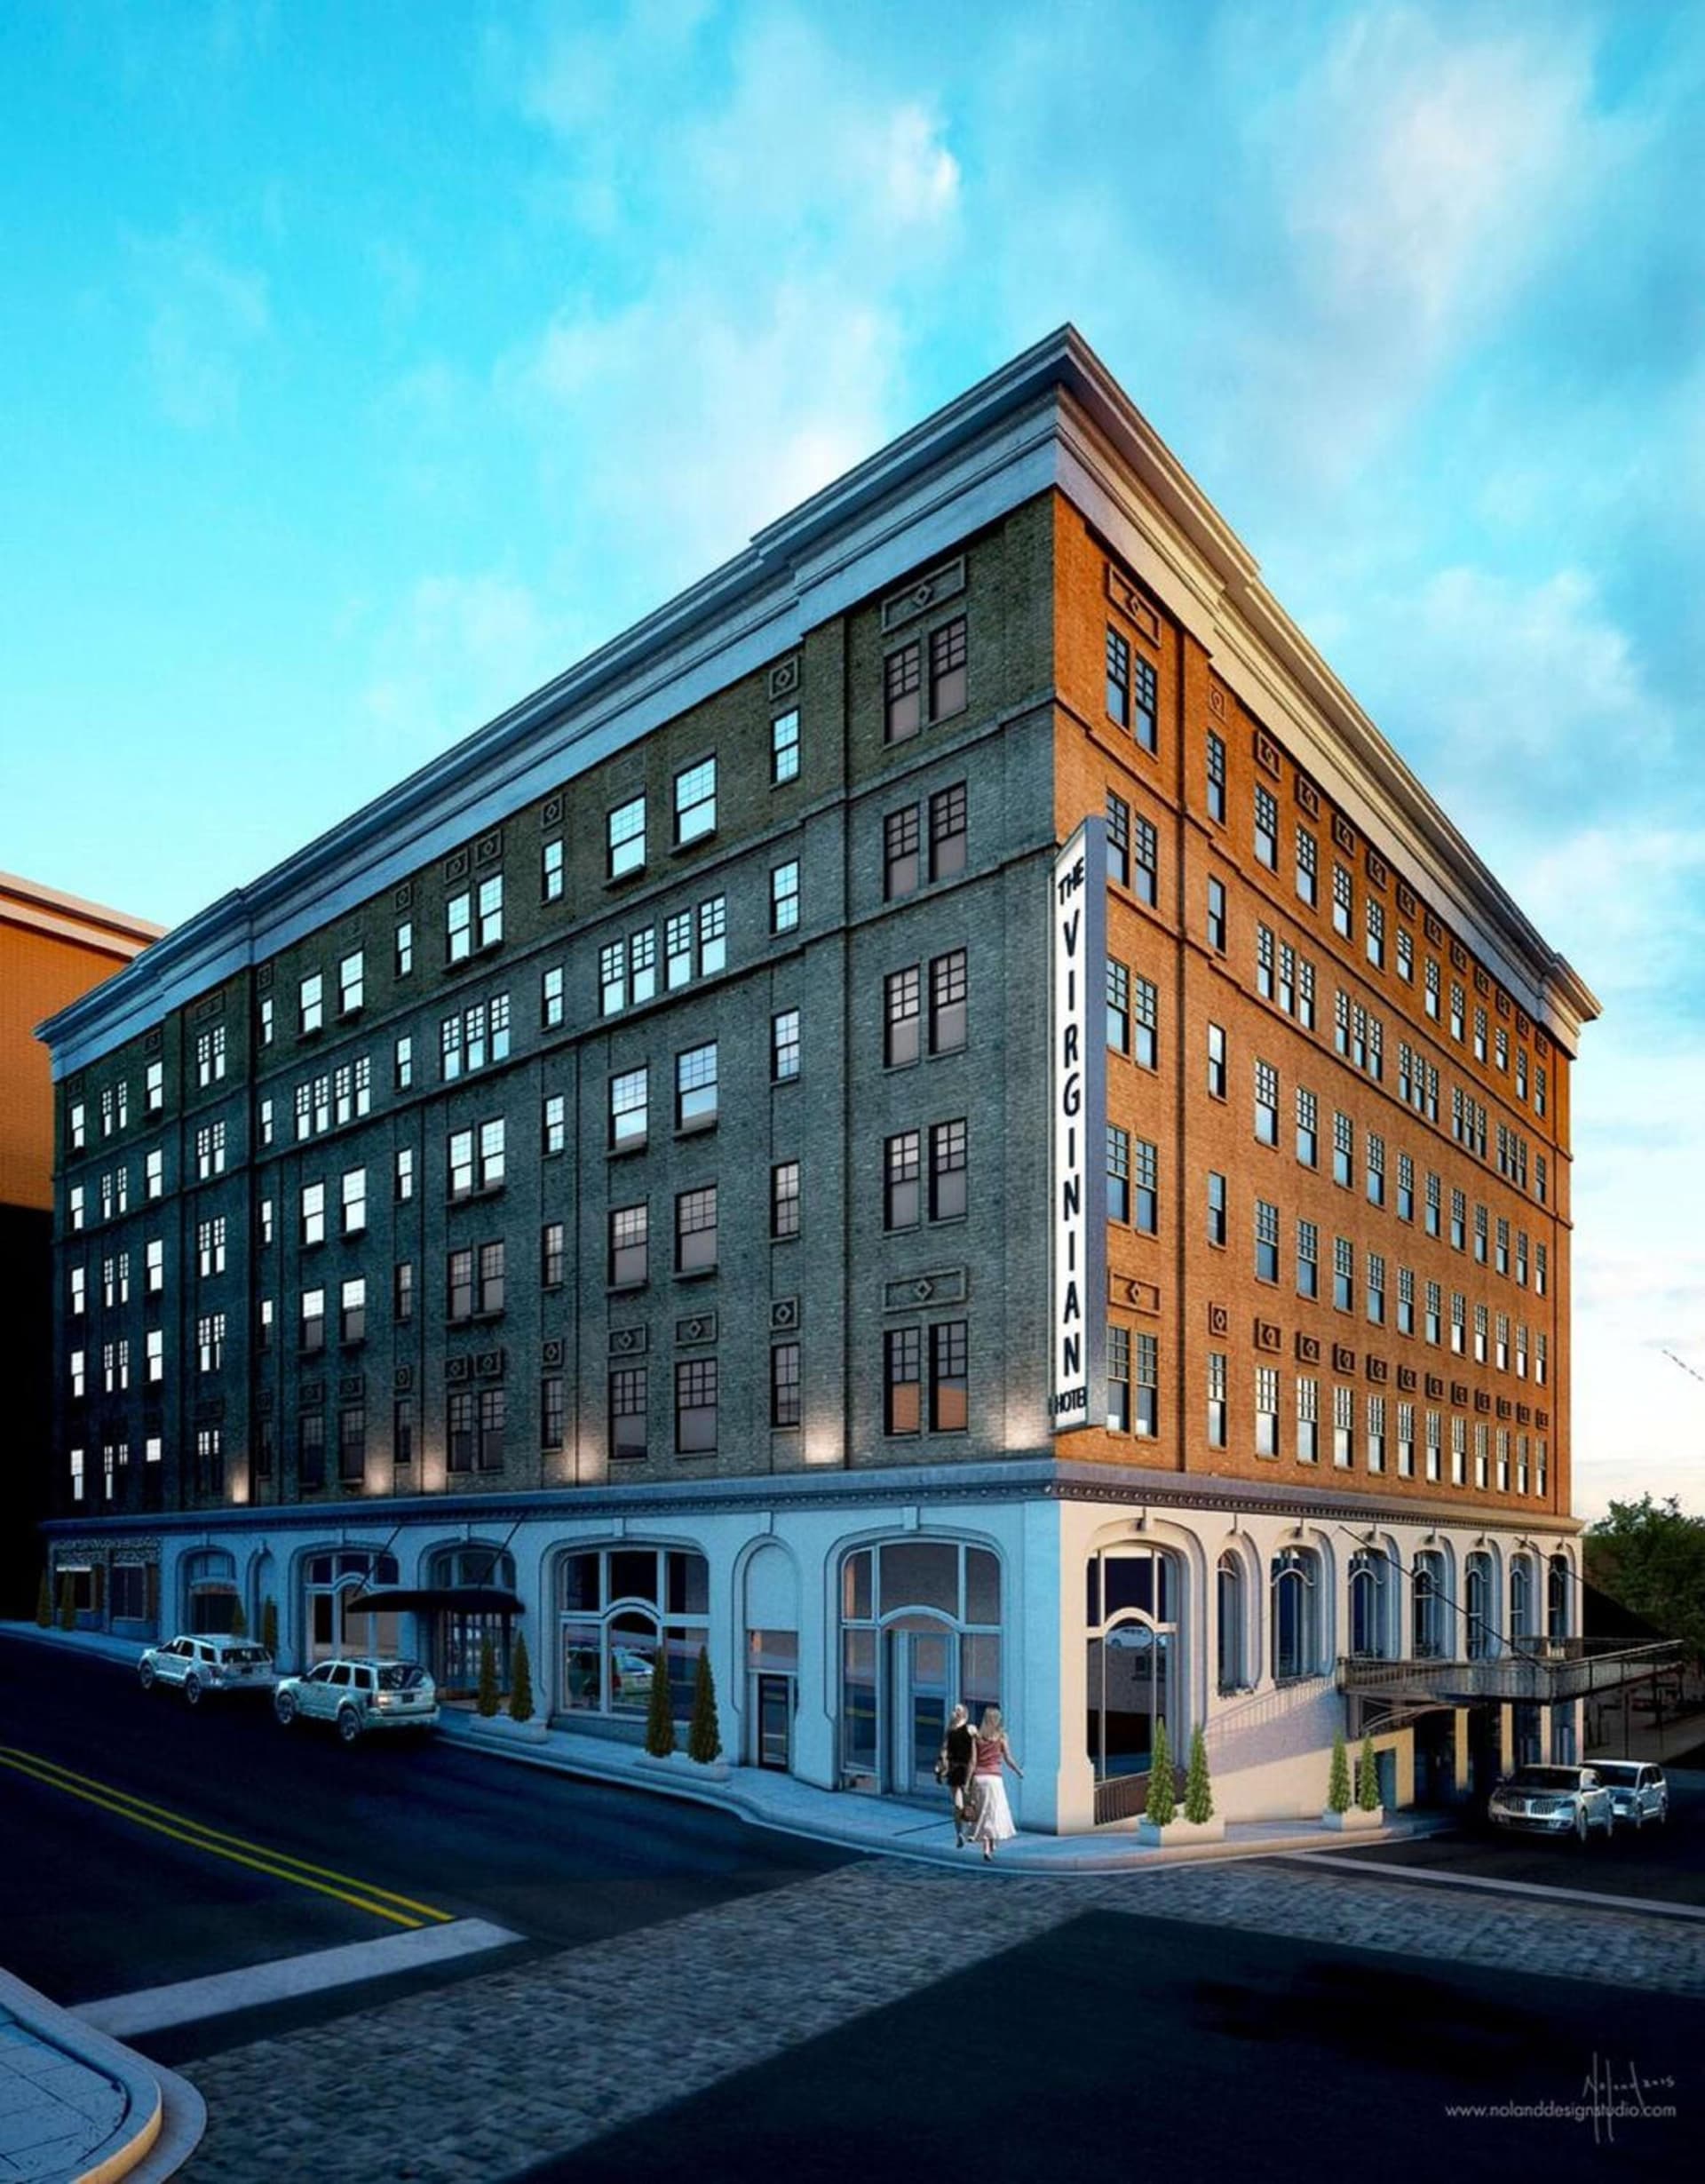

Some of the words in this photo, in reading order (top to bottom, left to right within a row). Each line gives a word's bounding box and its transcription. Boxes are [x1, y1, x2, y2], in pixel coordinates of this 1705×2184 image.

[1057, 856, 1084, 905] THE
[1063, 909, 1081, 1377] VIRGINIAN
[1054, 1386, 1088, 1414] HOTEL
